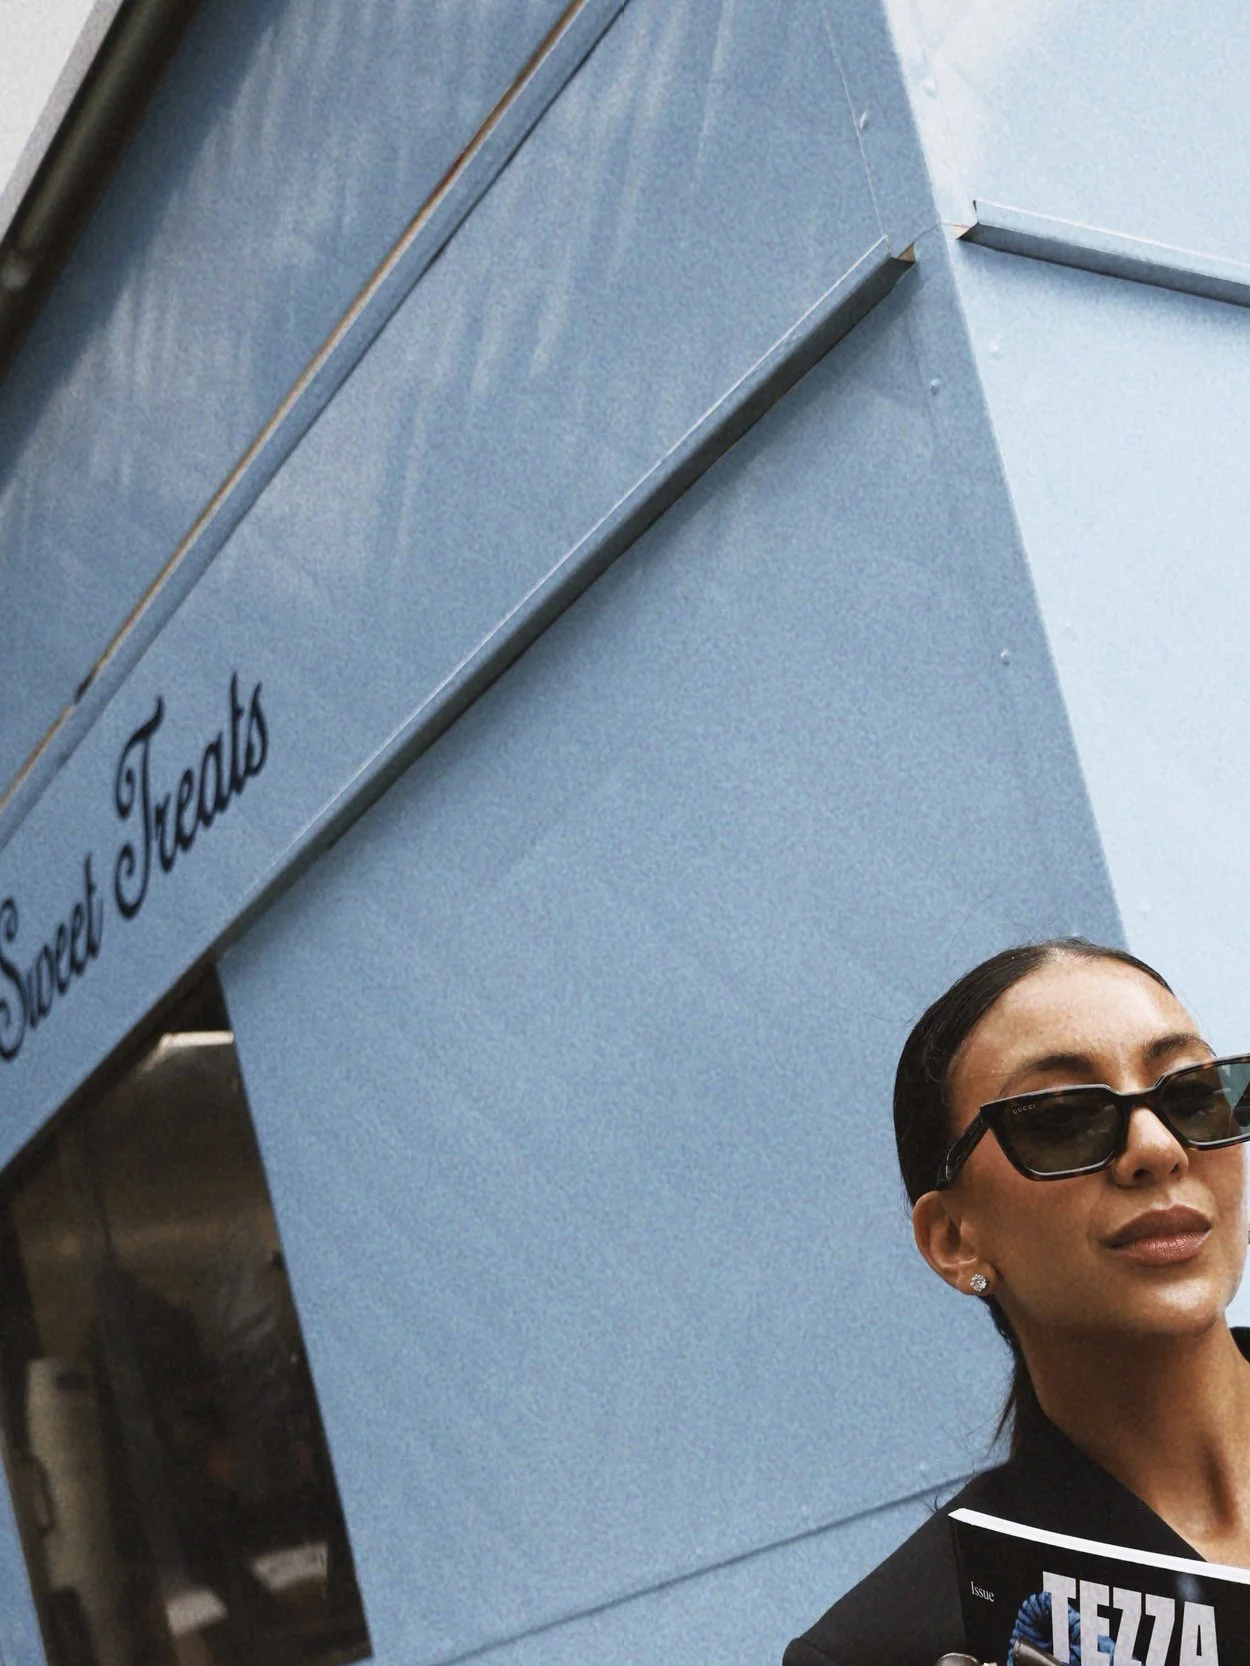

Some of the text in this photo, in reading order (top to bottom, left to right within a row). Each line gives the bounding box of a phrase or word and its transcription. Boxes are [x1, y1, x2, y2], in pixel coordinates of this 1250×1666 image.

[0, 671, 268, 1061] Sweet Treats
[1012, 1104, 1036, 1115] GUCCI
[970, 1580, 995, 1602] Issue
